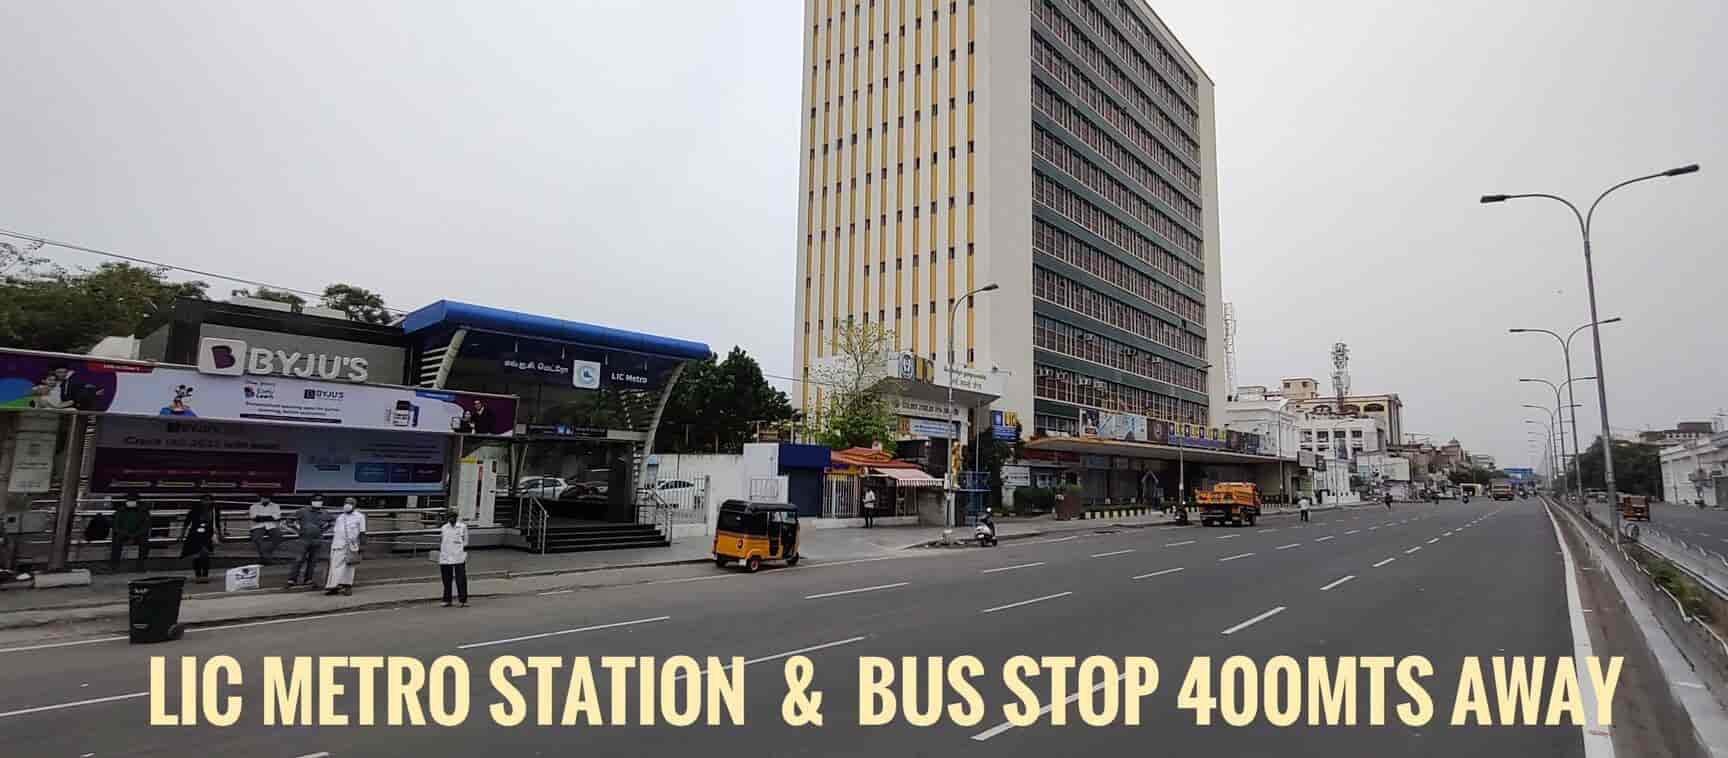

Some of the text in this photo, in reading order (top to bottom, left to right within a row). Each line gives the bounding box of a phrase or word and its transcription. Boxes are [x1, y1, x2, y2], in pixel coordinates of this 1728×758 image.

[249, 347, 369, 383] BYJU'S
[611, 372, 648, 384] LIC Metro
